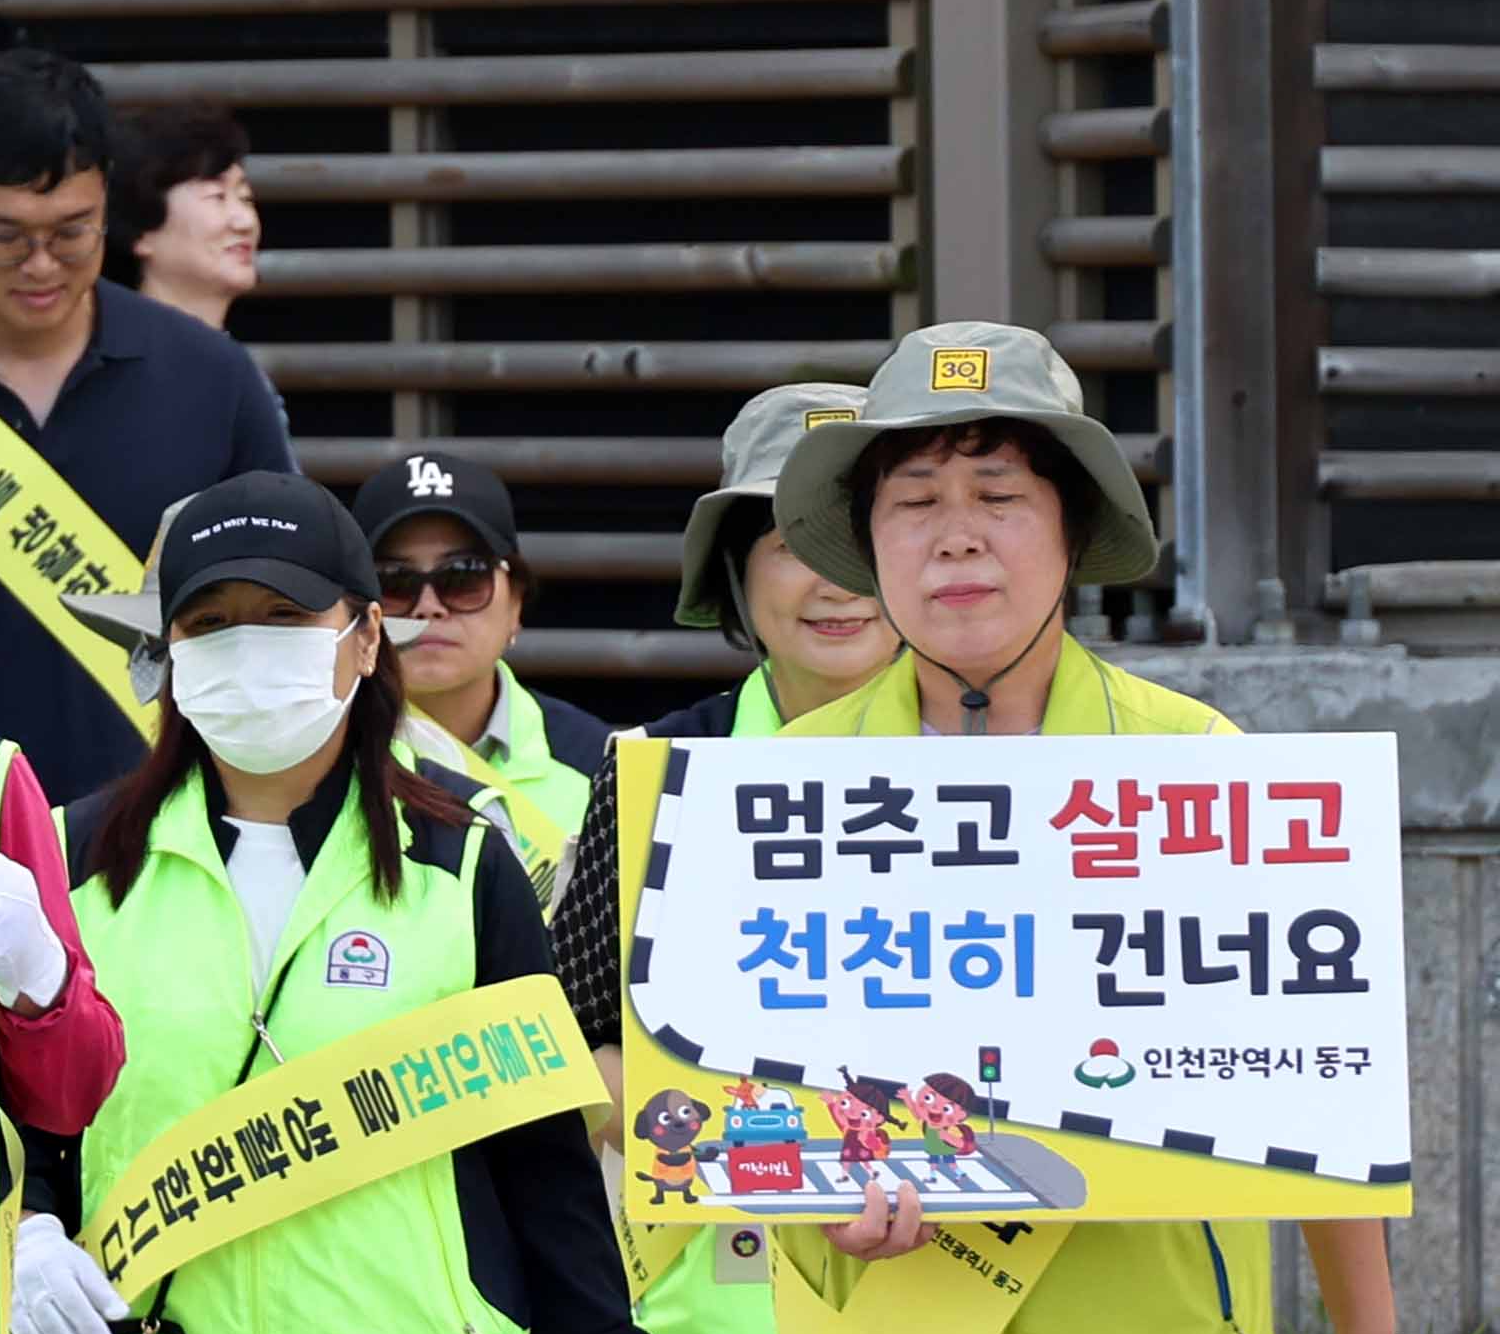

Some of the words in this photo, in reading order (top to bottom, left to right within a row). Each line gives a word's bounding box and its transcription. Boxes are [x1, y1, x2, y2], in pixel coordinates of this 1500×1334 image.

[407, 456, 453, 497] LA
[9, 504, 130, 595] 생활화
[223, 517, 249, 530] WHY
[251, 516, 269, 528] WE
[271, 520, 299, 534] PLAY
[735, 776, 1019, 880] 멈추고
[1049, 779, 1351, 878] 살피고
[737, 907, 1035, 1009] 천천히
[1072, 908, 1370, 1007] 건너요
[343, 1013, 569, 1138] 교통안전을
[1143, 1046, 1304, 1080] 인천광역시
[1313, 1046, 1372, 1079] 동구
[99, 1096, 339, 1284] 생활화합시다
[994, 1269, 1024, 1297] 동구
